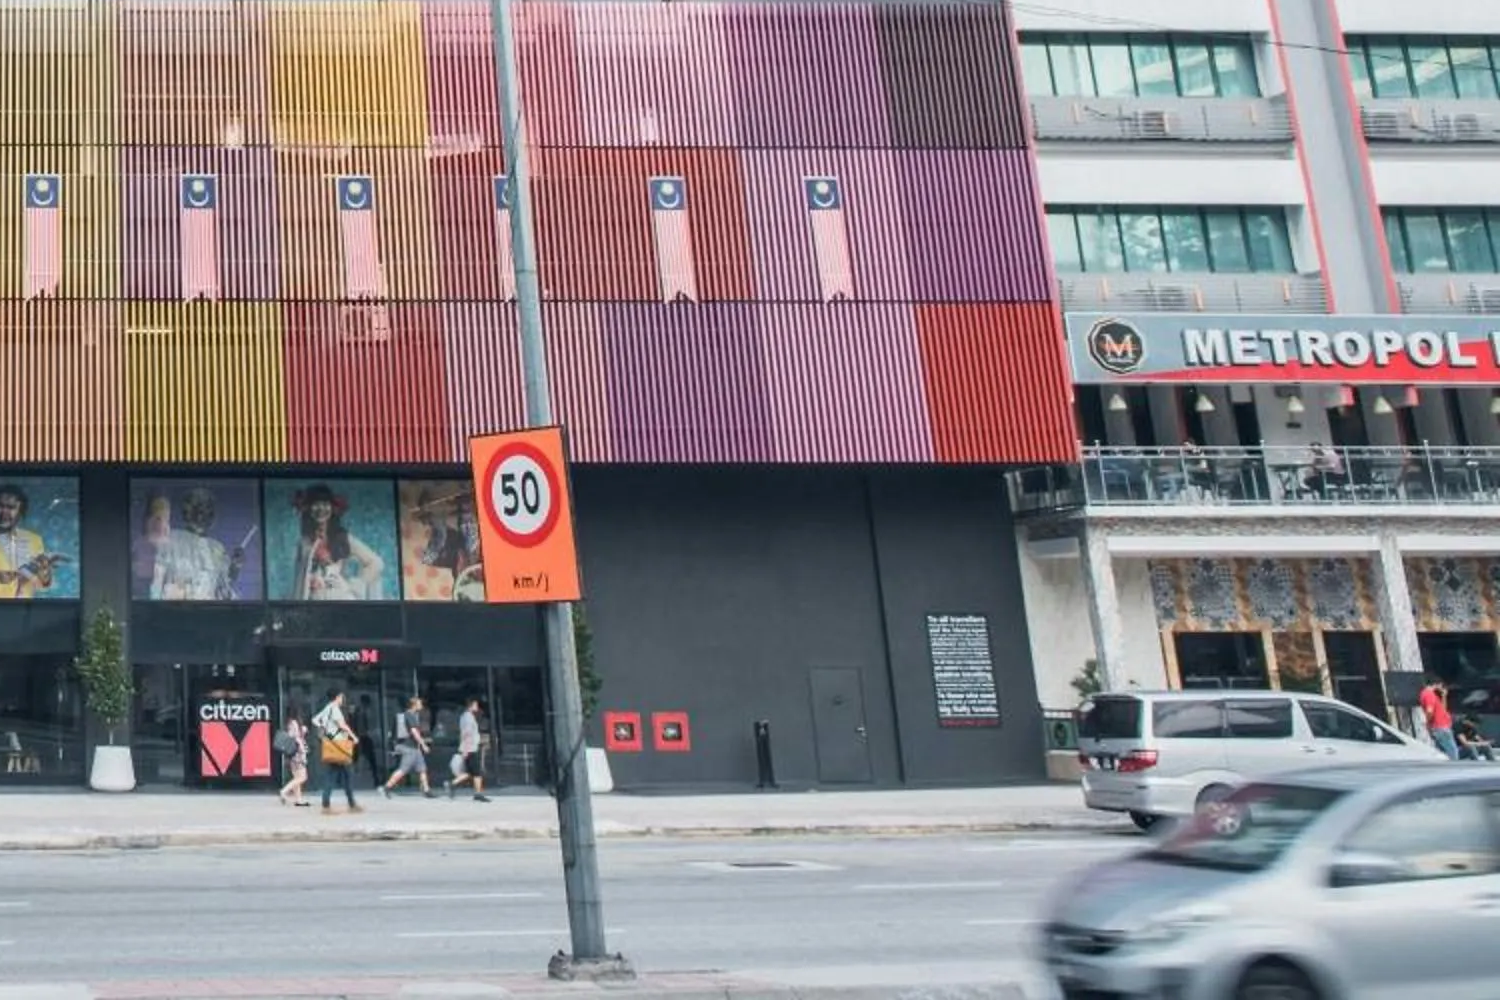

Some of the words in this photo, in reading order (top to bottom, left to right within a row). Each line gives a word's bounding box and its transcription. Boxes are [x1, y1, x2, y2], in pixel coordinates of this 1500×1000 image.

[1181, 328, 1477, 367] METROPOL
[501, 470, 540, 517] 50
[513, 572, 549, 592] km/j
[200, 699, 270, 720] citizen
